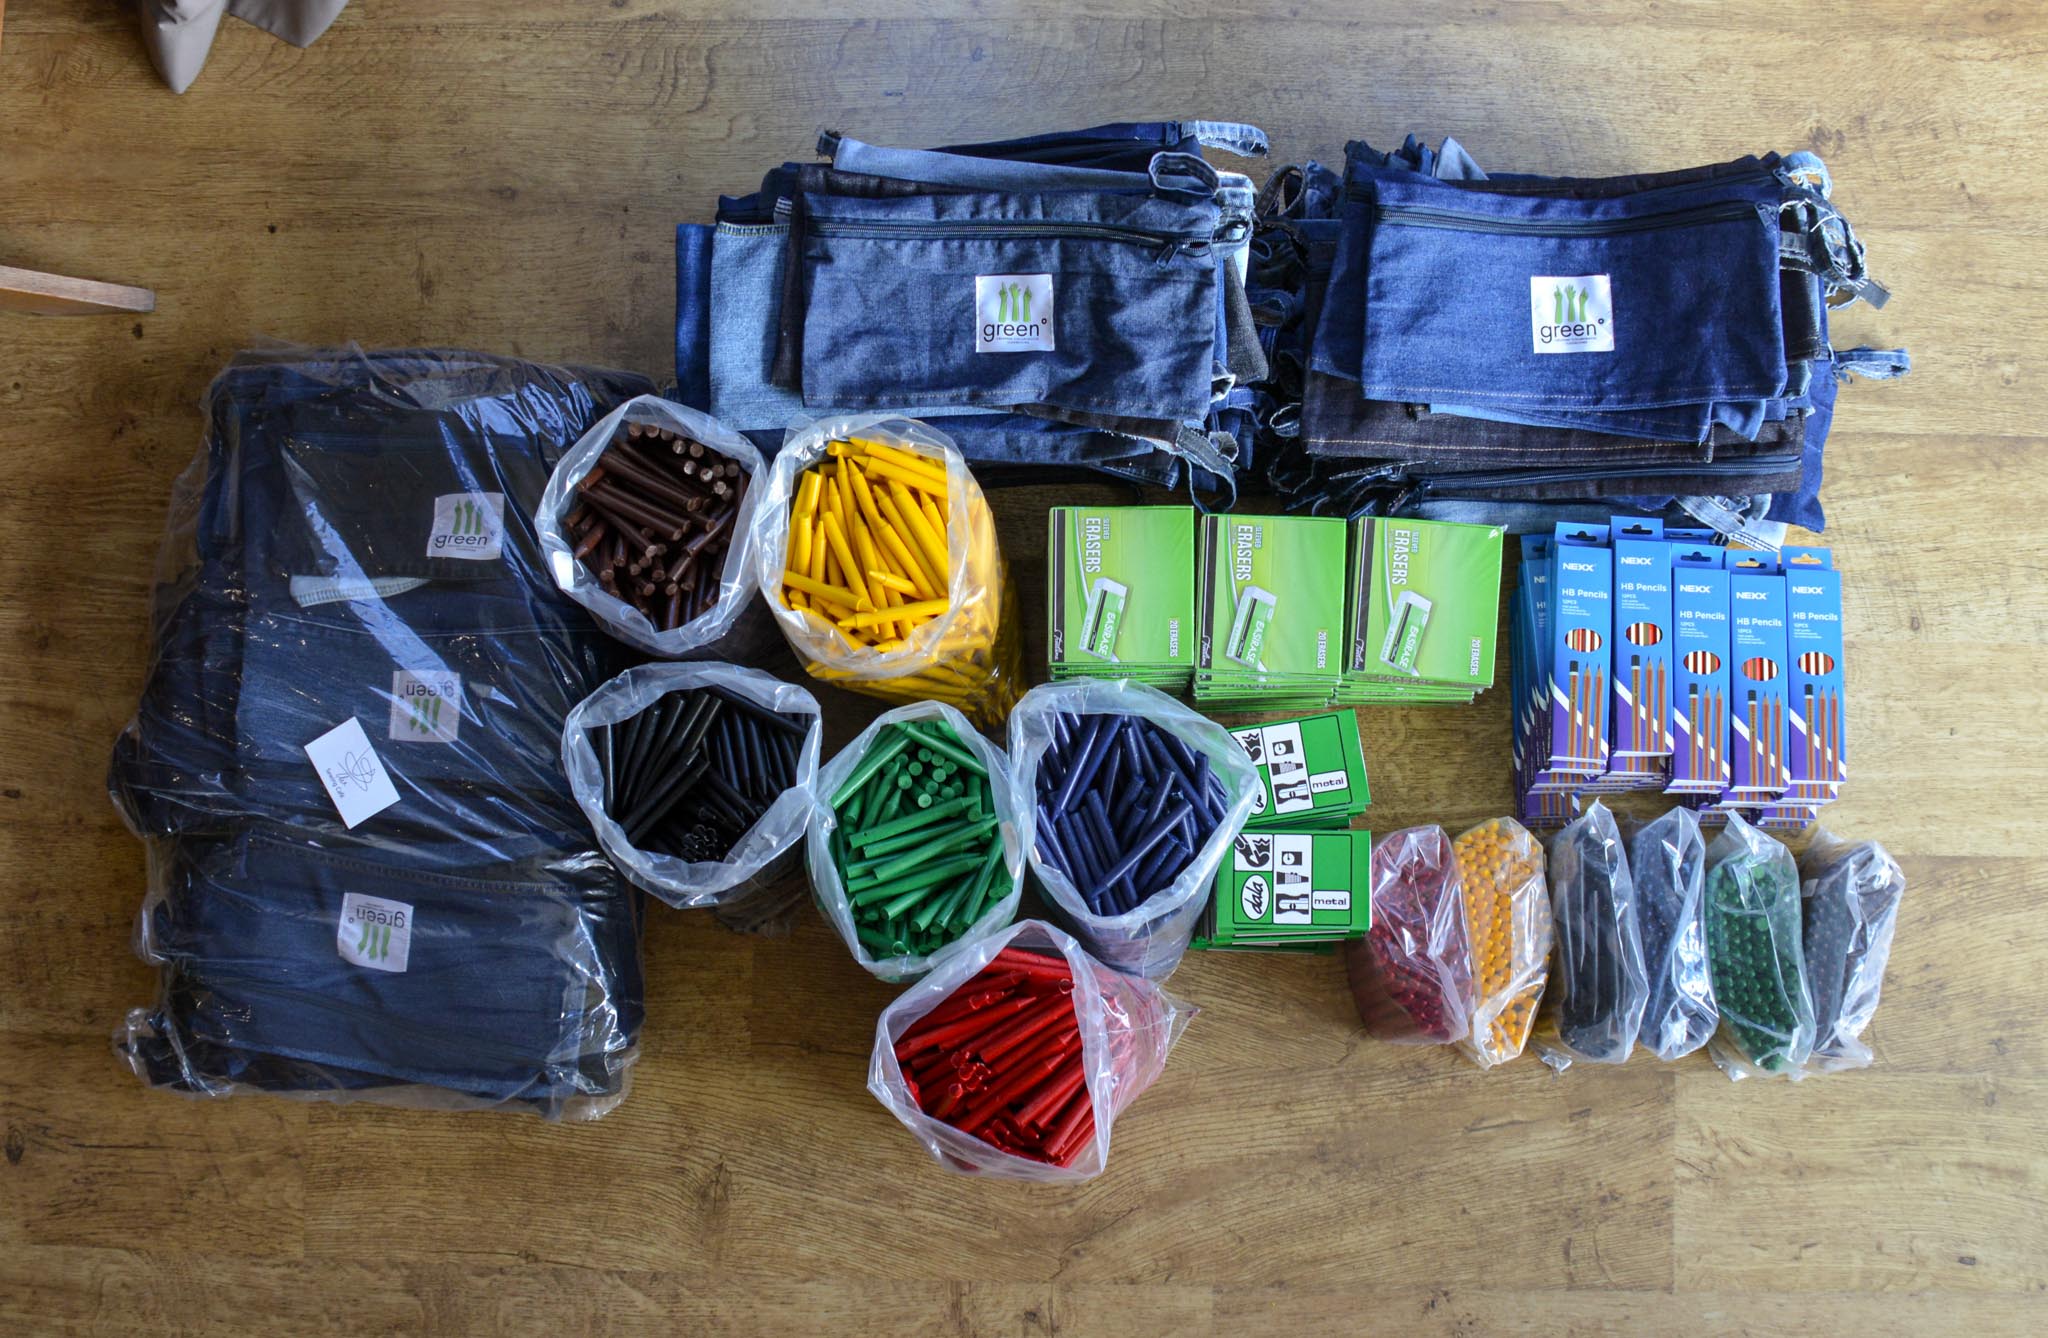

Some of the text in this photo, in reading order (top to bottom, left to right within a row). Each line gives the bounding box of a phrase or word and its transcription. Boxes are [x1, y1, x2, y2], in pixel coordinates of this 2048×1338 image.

[1086, 518, 1101, 573] ERASERS
[1237, 526, 1253, 581] ERASERS
[1392, 530, 1411, 585] ERASERS
[1621, 557, 1652, 565] NEXX
[1562, 562, 1594, 572] NEXX
[1636, 584, 1667, 592] Pencils
[1680, 584, 1711, 593] NEXX
[1792, 586, 1823, 595] NEXX
[1577, 590, 1608, 599] Pencils
[1736, 592, 1767, 600] NEXX
[1695, 611, 1726, 621] Pencils
[1808, 612, 1838, 621] Pencils
[1752, 618, 1782, 627] Pencils
[1170, 630, 1178, 657] ERASERS
[1317, 641, 1326, 668] ERASERS
[1470, 649, 1480, 675] ERASERS
[1312, 777, 1344, 789] metal
[1244, 881, 1263, 914] dala
